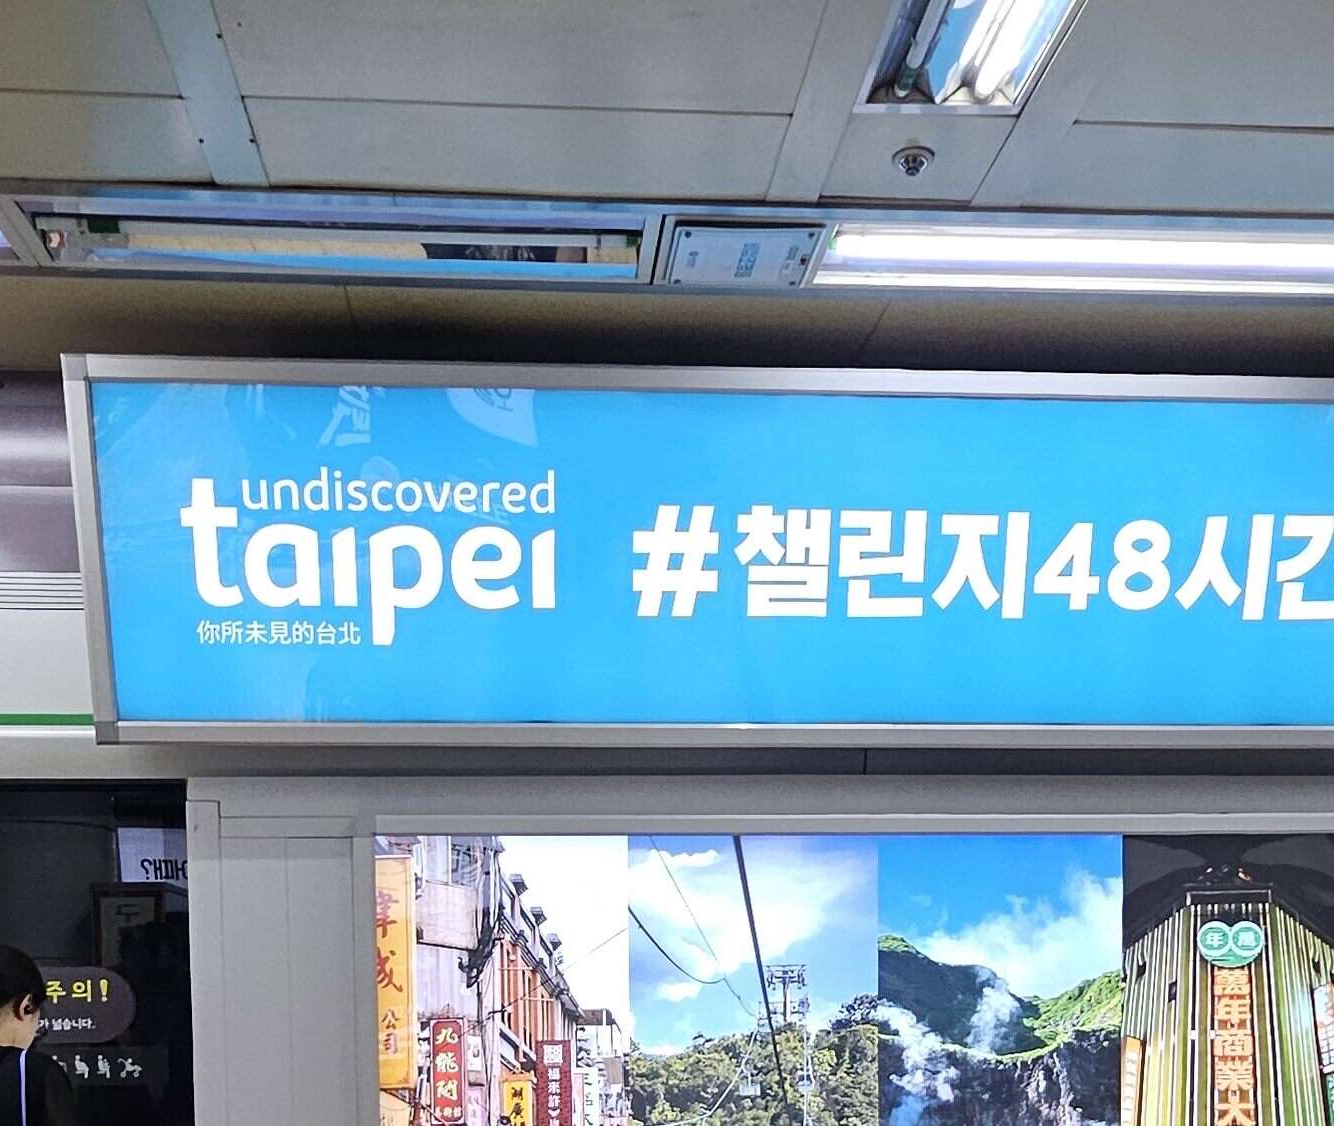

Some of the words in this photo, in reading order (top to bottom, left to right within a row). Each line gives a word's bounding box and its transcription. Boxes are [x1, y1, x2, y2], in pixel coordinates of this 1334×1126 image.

[242, 466, 555, 513] undiscovered
[180, 477, 555, 645] taipei
[197, 620, 361, 645] 你所未見的台北
[46, 979, 109, 1004] 주의!
